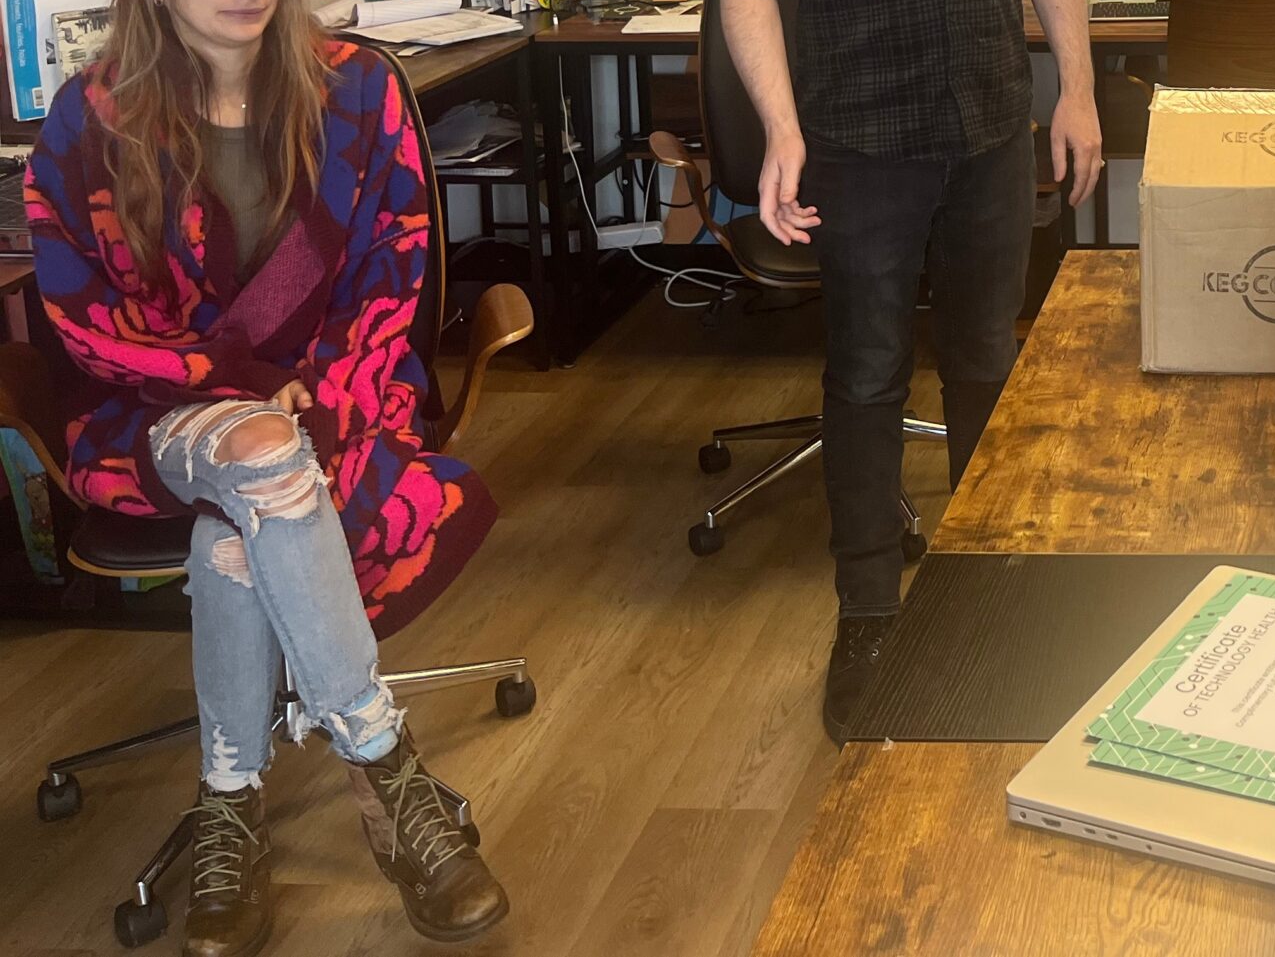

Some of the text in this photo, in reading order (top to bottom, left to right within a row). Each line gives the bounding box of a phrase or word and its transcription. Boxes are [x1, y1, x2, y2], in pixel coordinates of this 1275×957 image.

[1175, 623, 1248, 694] Certificate
[1182, 701, 1205, 717] OF
[1194, 639, 1257, 702] TECHNOLOGY
